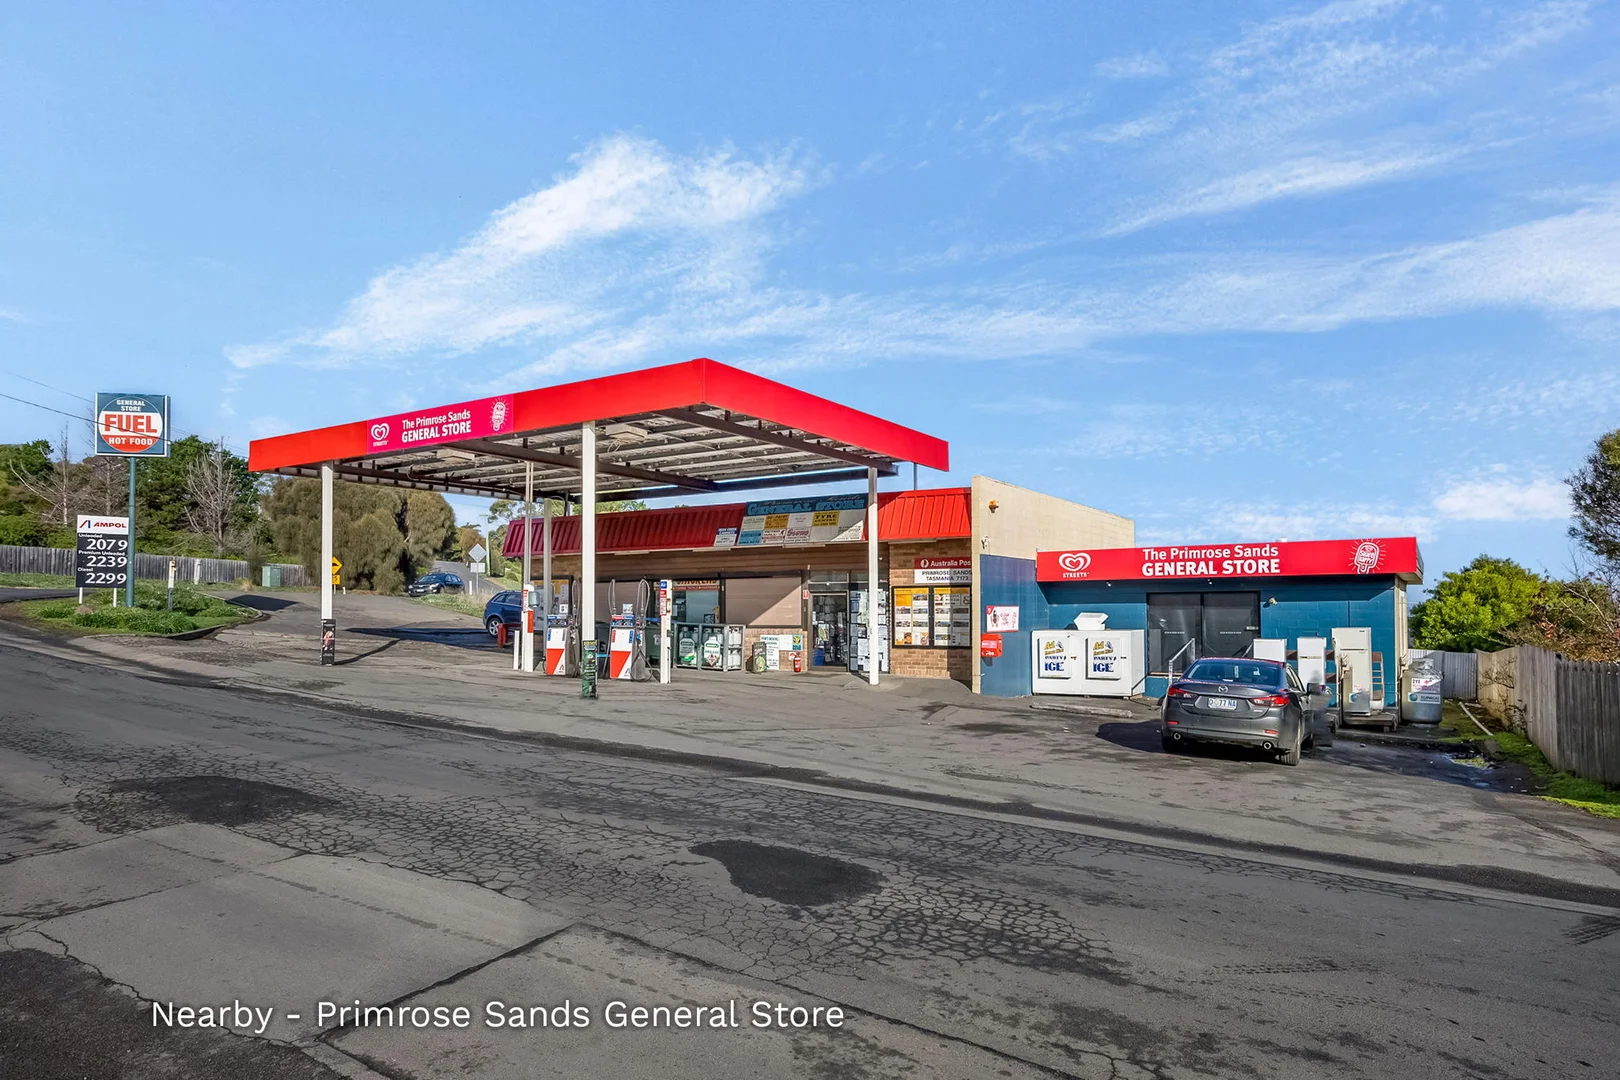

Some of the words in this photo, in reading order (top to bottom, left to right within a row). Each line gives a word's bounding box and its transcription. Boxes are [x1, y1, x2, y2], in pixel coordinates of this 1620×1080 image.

[105, 414, 157, 433] FUEL
[402, 419, 414, 430] The
[416, 414, 447, 427] Primrose
[448, 409, 471, 421] Sands
[401, 427, 440, 443] GENERAL
[442, 421, 471, 437] STORE
[748, 502, 812, 515] GENERAL
[815, 500, 864, 511] STORE
[86, 539, 128, 550] 2079
[1142, 549, 1166, 560] The
[1170, 546, 1230, 560] Primrose
[1235, 544, 1279, 557] Sands
[86, 556, 127, 567] 2239
[1142, 560, 1217, 576] GENERAL
[1222, 559, 1281, 574] STORE
[85, 572, 127, 584] 2299
[1044, 662, 1064, 671] ICE
[1093, 663, 1113, 672] ICE
